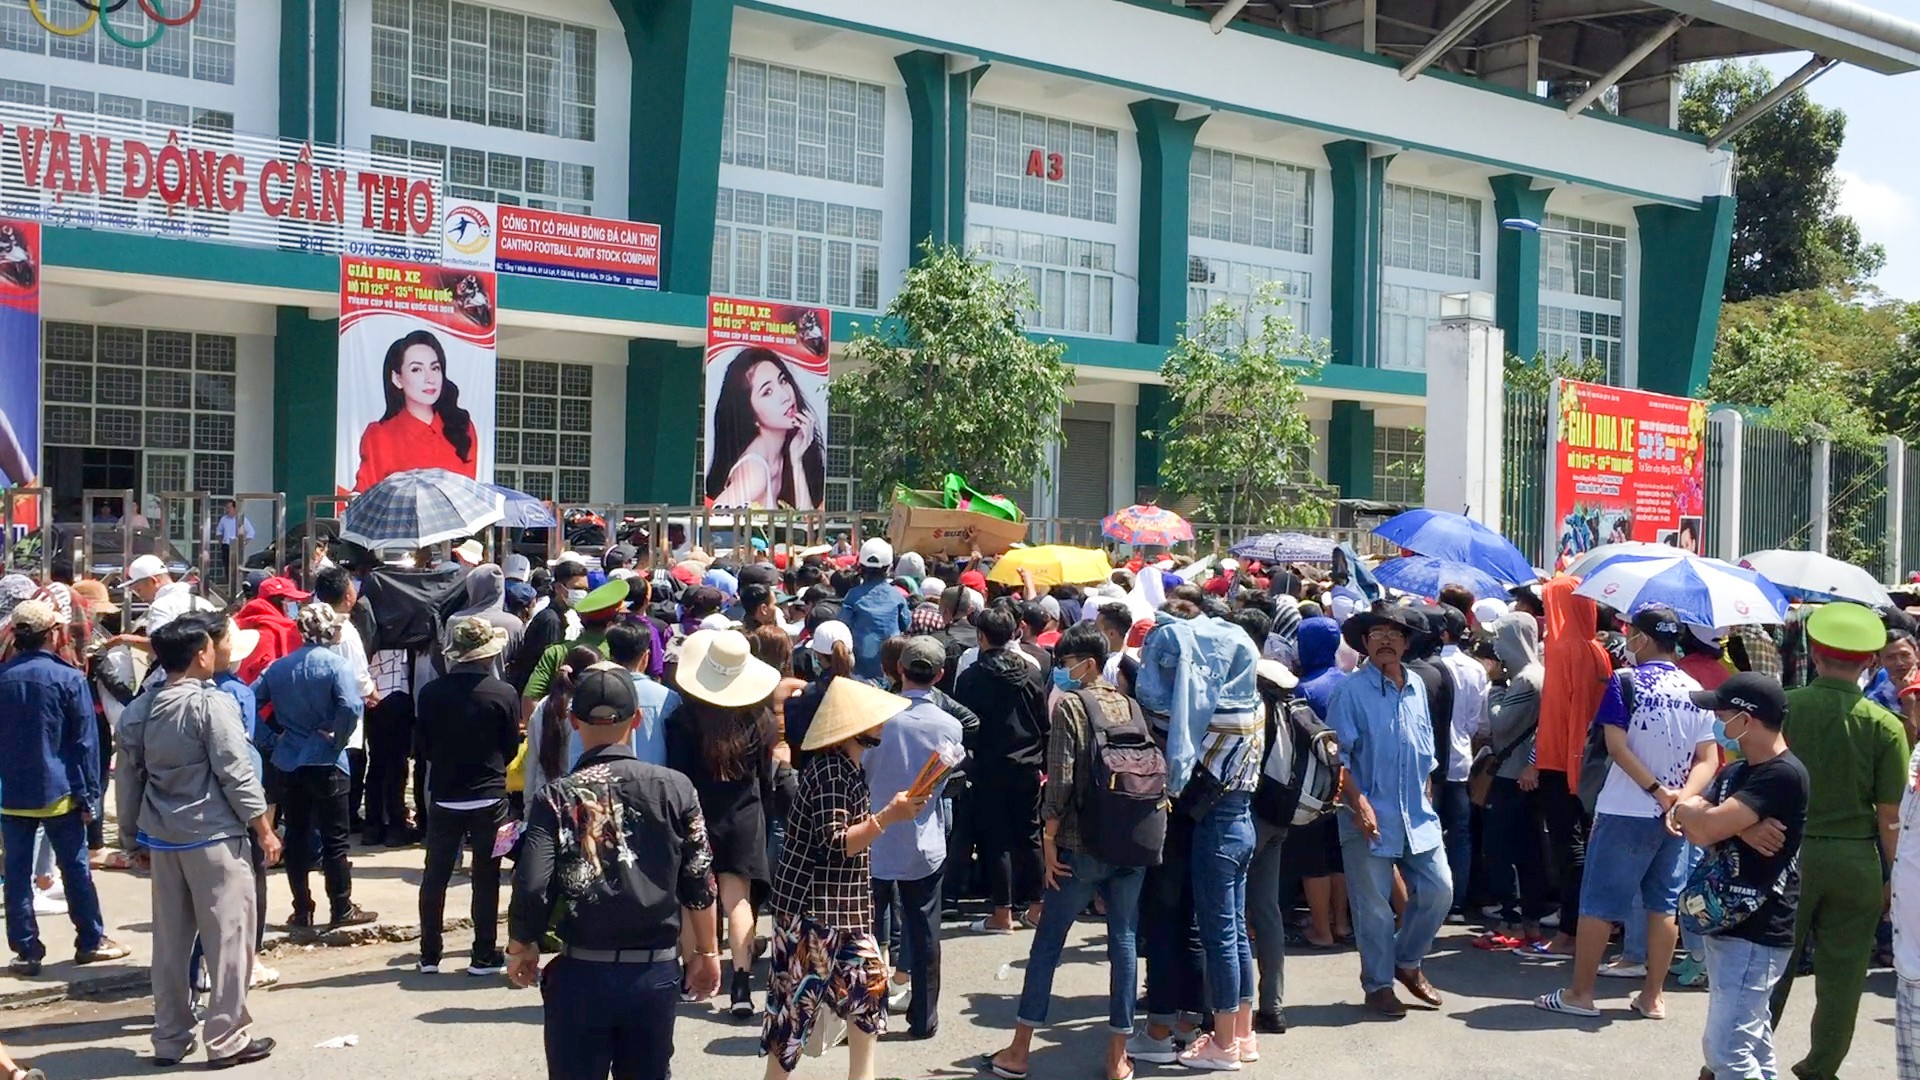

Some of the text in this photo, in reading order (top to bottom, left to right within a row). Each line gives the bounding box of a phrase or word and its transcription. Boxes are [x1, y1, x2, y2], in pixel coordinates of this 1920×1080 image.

[16, 113, 436, 236] VẬN ĐỘNG CẦN THƠ
[1026, 149, 1064, 180] A3
[529, 219, 541, 233] TY
[581, 224, 605, 240] BÓNG
[607, 227, 619, 243] ĐÁ
[639, 233, 657, 247] THƠ
[501, 237, 533, 253] CANTHO
[534, 241, 573, 257] FOOTBALL
[574, 246, 595, 260] JOINT
[596, 249, 621, 262] STOCK
[622, 252, 656, 267] COMPANY
[347, 261, 421, 284] GIẢI ĐUA XE
[713, 300, 734, 315] GIẢI
[758, 307, 771, 319] XE
[1568, 403, 1592, 448] GIẢI
[1595, 413, 1617, 451] ĐUA
[1620, 417, 1635, 453] XE
[1731, 697, 1758, 712] GVC
